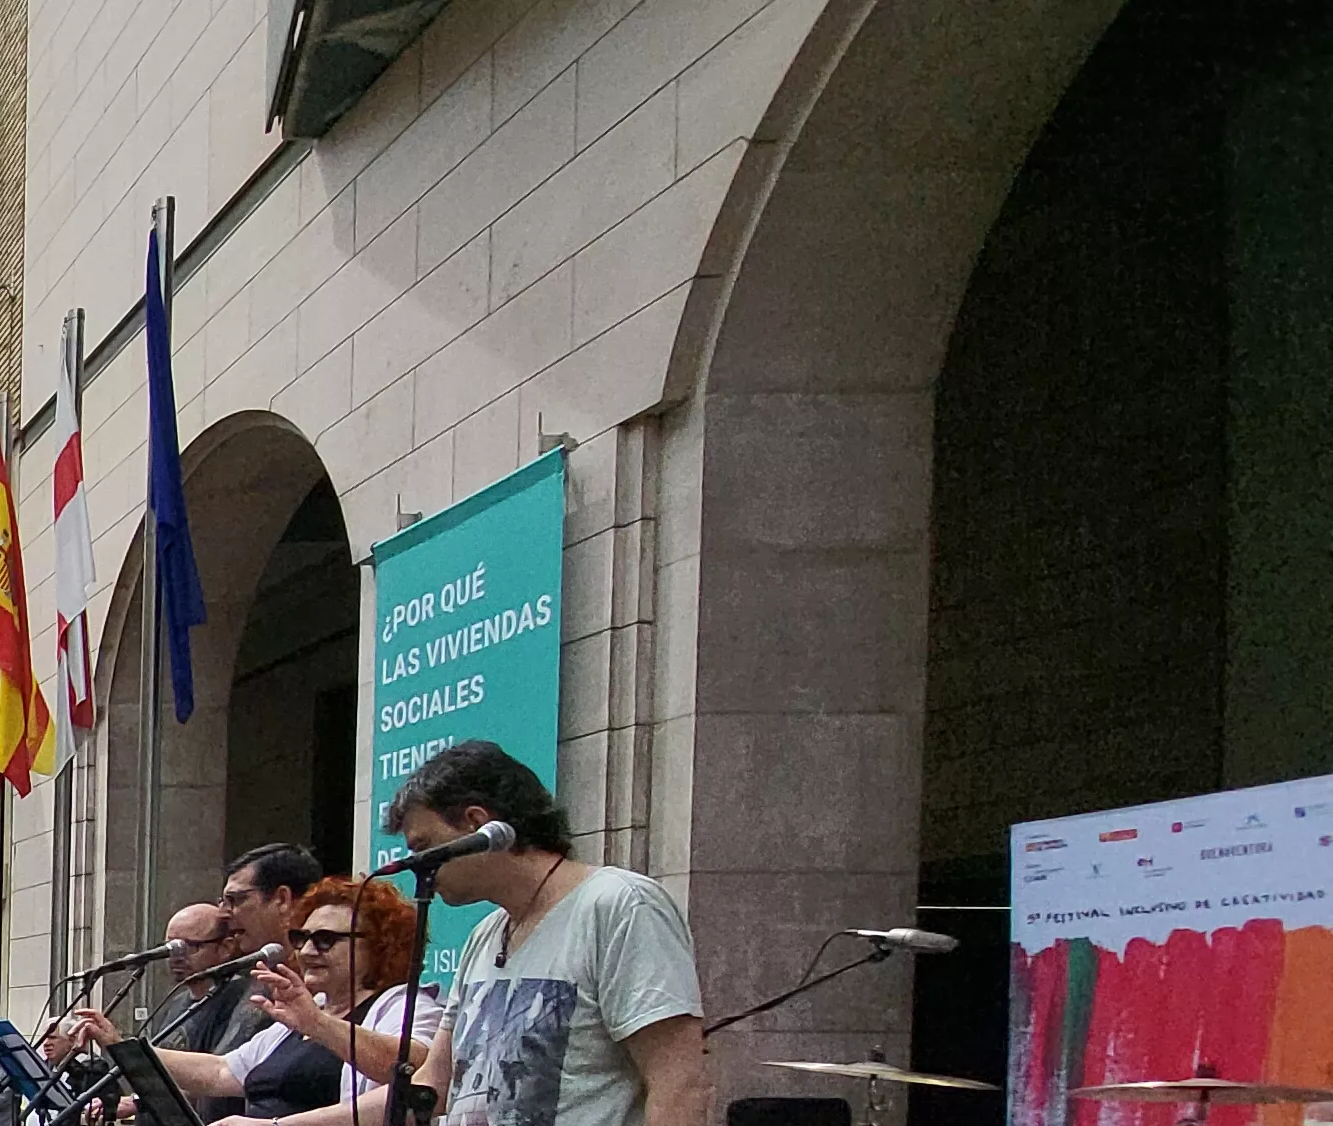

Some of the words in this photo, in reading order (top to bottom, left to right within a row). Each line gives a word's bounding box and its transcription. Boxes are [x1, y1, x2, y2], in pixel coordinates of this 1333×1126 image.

[382, 592, 434, 643] ¿POR
[440, 560, 486, 613] QUÉ
[382, 647, 421, 685] LAS
[426, 594, 553, 668] VIVIENDAS
[380, 674, 485, 732] SOCIALES
[433, 948, 459, 973] ISL
